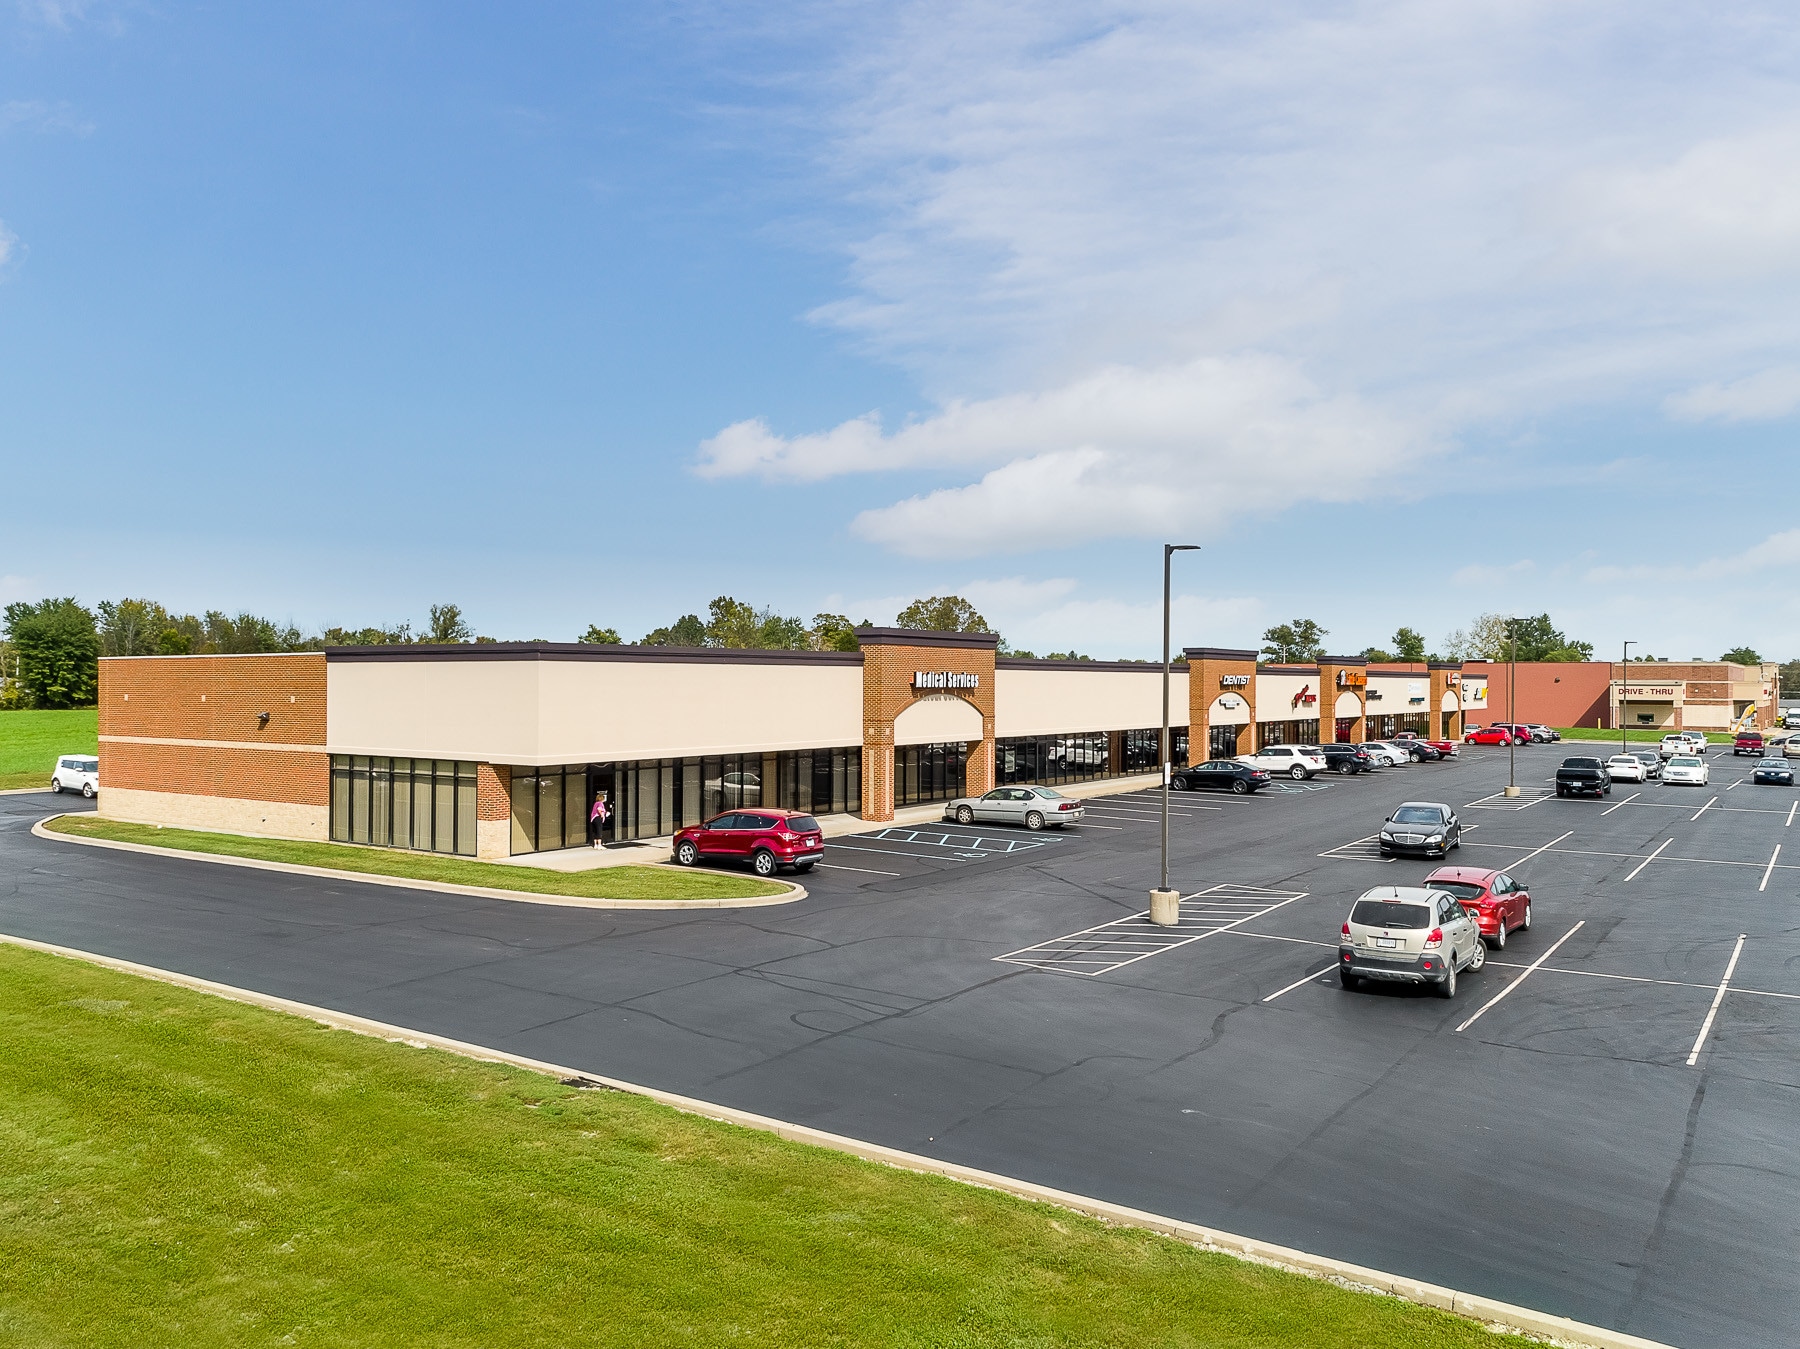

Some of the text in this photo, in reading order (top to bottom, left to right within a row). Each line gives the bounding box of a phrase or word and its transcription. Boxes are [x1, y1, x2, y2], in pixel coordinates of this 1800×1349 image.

[916, 671, 978, 688] Medical Services
[1223, 675, 1250, 684] DENTIST
